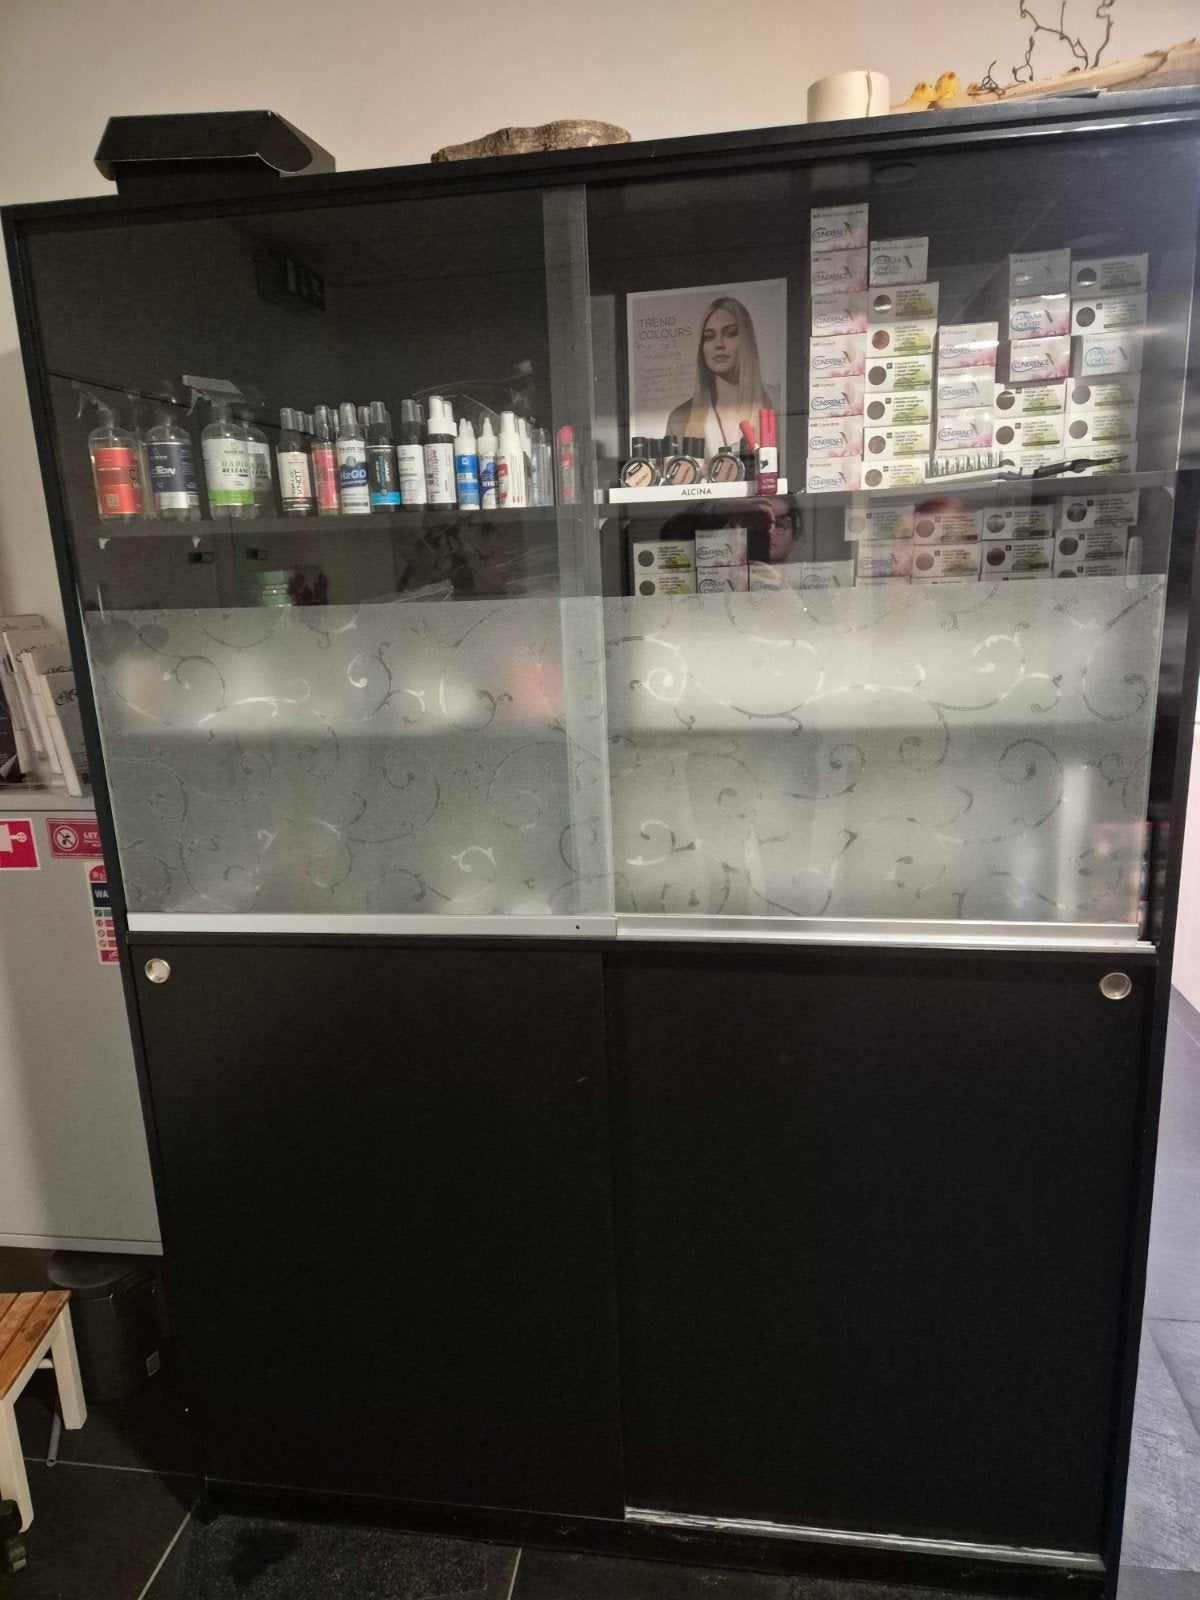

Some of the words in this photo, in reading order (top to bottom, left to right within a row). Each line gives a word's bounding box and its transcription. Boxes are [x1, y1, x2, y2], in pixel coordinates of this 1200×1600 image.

[639, 317, 676, 328] TREND
[639, 327, 692, 340] COLOURS
[295, 470, 303, 495] KNOT
[681, 488, 712, 496] ALCINA
